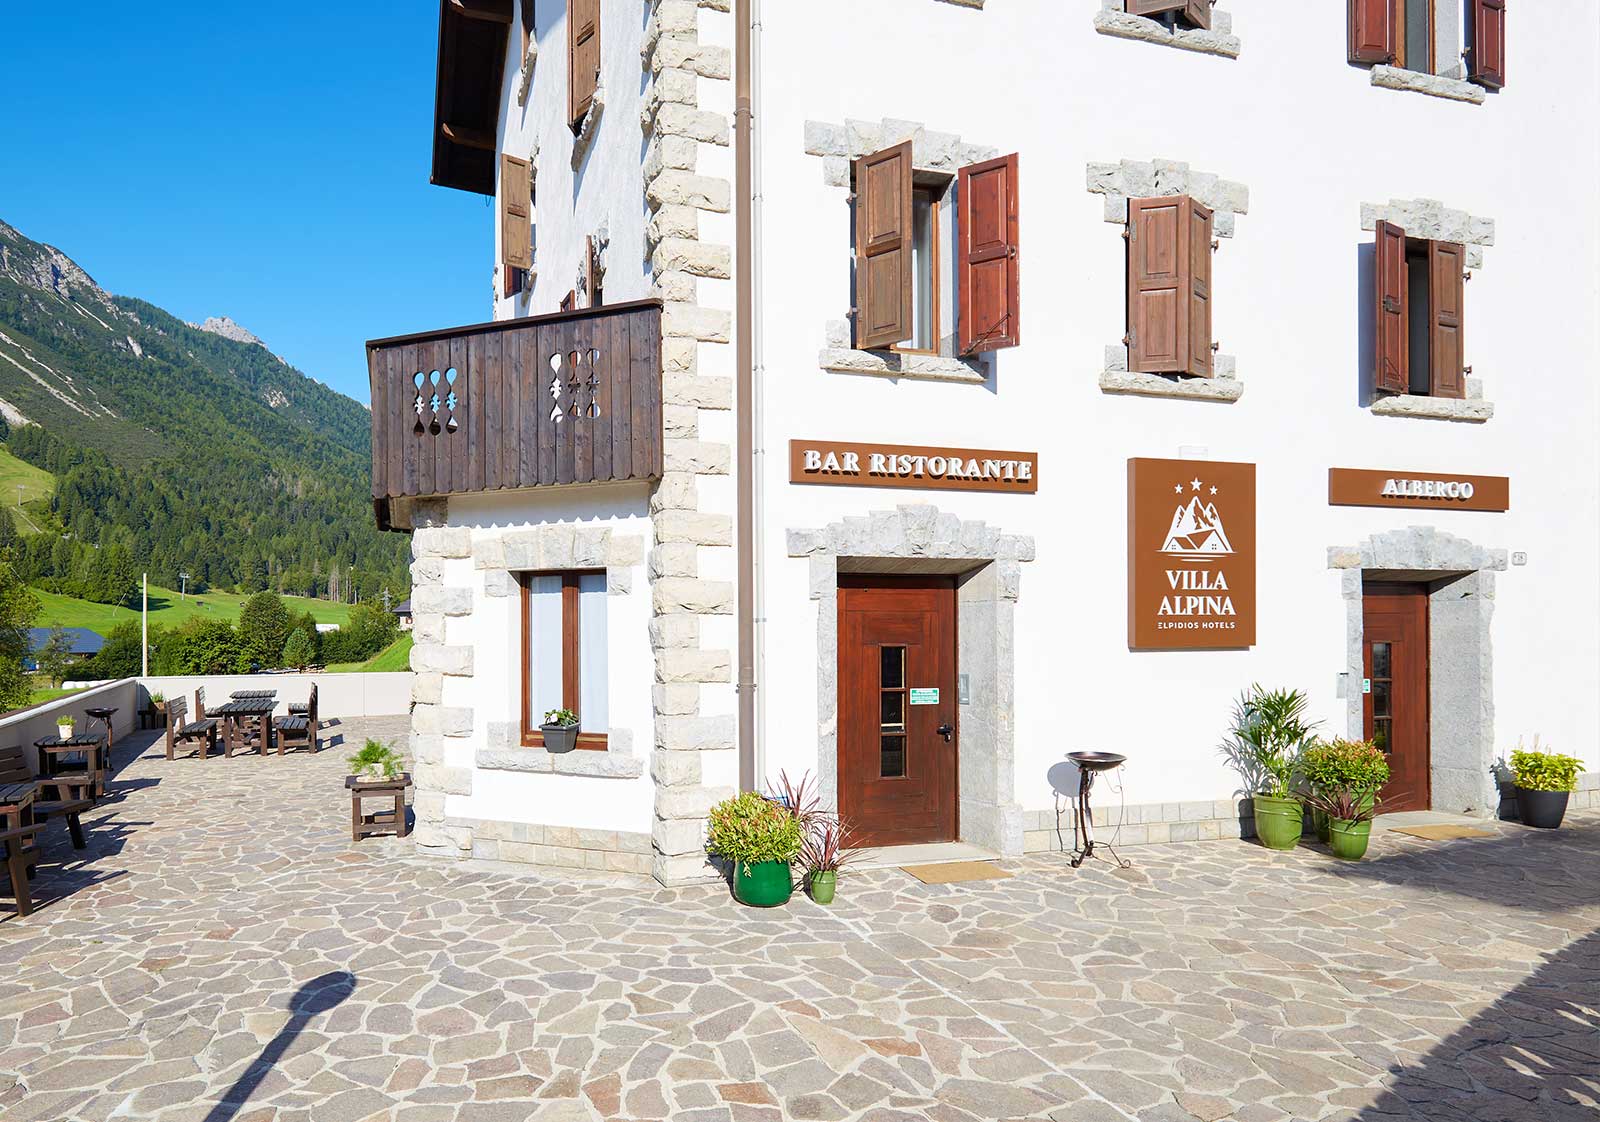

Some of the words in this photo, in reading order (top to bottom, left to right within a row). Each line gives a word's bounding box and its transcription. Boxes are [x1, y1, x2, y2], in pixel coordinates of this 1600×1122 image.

[803, 450, 861, 474] BAR
[868, 453, 1032, 481] RISTORANTE
[1382, 478, 1474, 499] ALBERGO
[1165, 569, 1229, 590] VILLA
[1157, 595, 1237, 616] ALPINA
